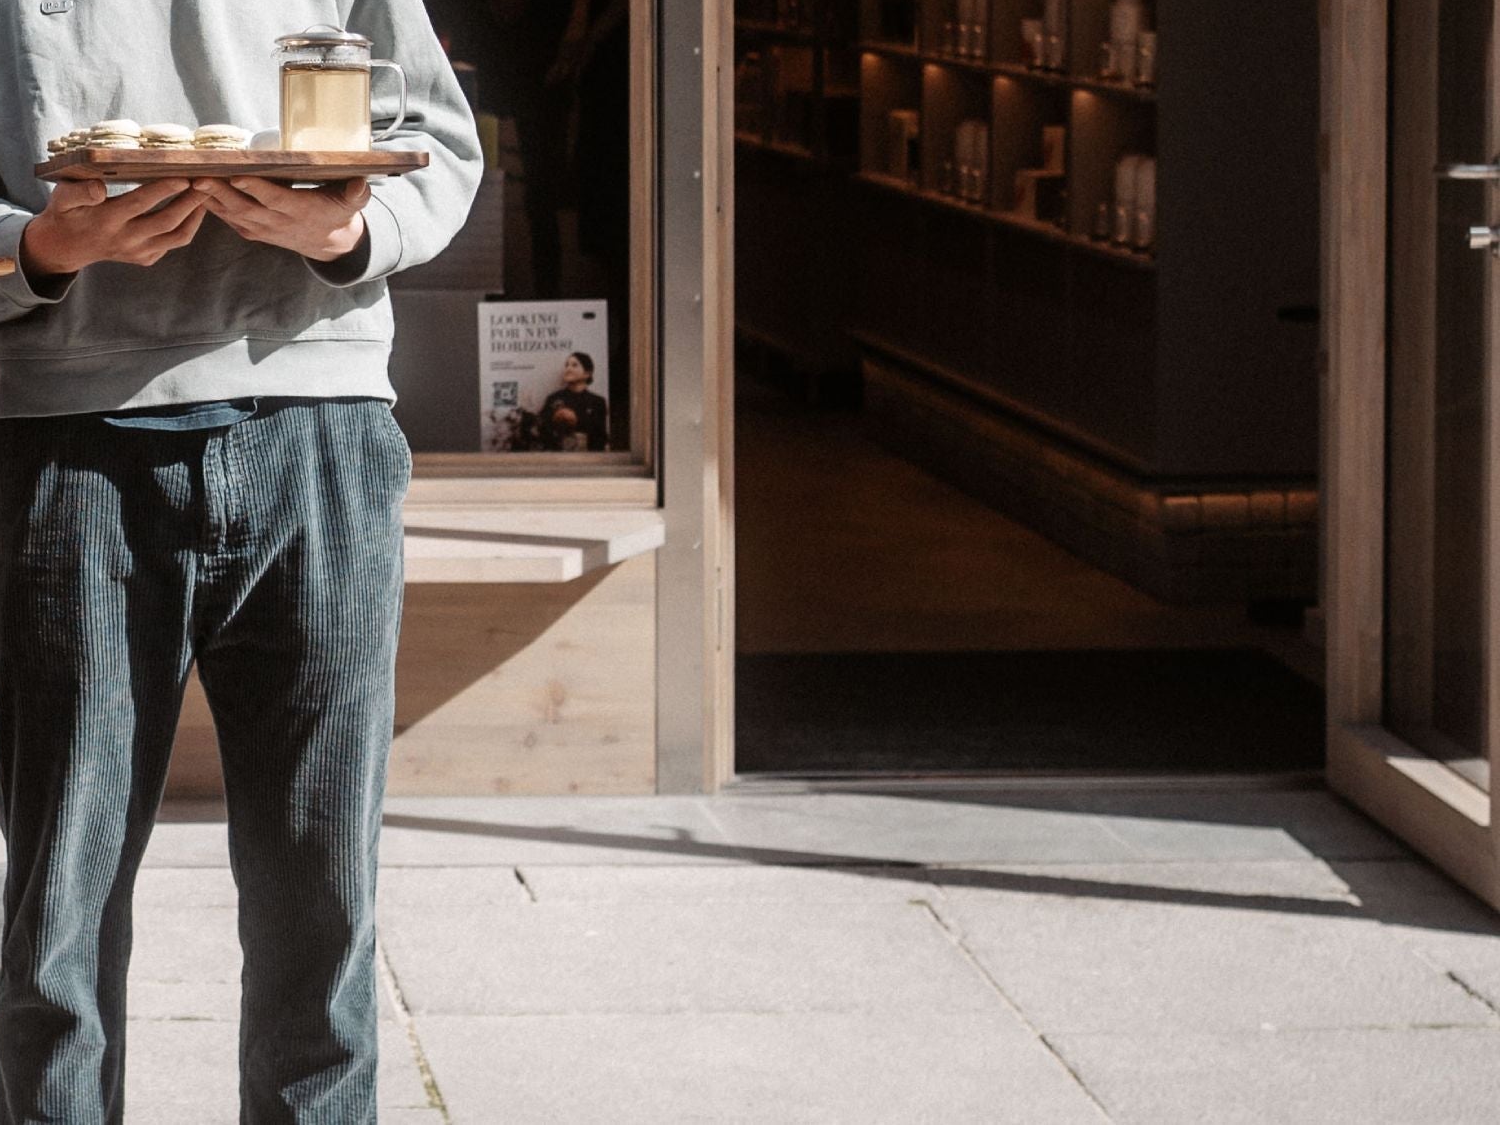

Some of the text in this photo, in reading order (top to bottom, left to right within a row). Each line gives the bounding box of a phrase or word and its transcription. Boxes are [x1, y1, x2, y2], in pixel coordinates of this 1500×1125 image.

[490, 313, 558, 325] LOOKING
[490, 327, 560, 339] FOR NEW
